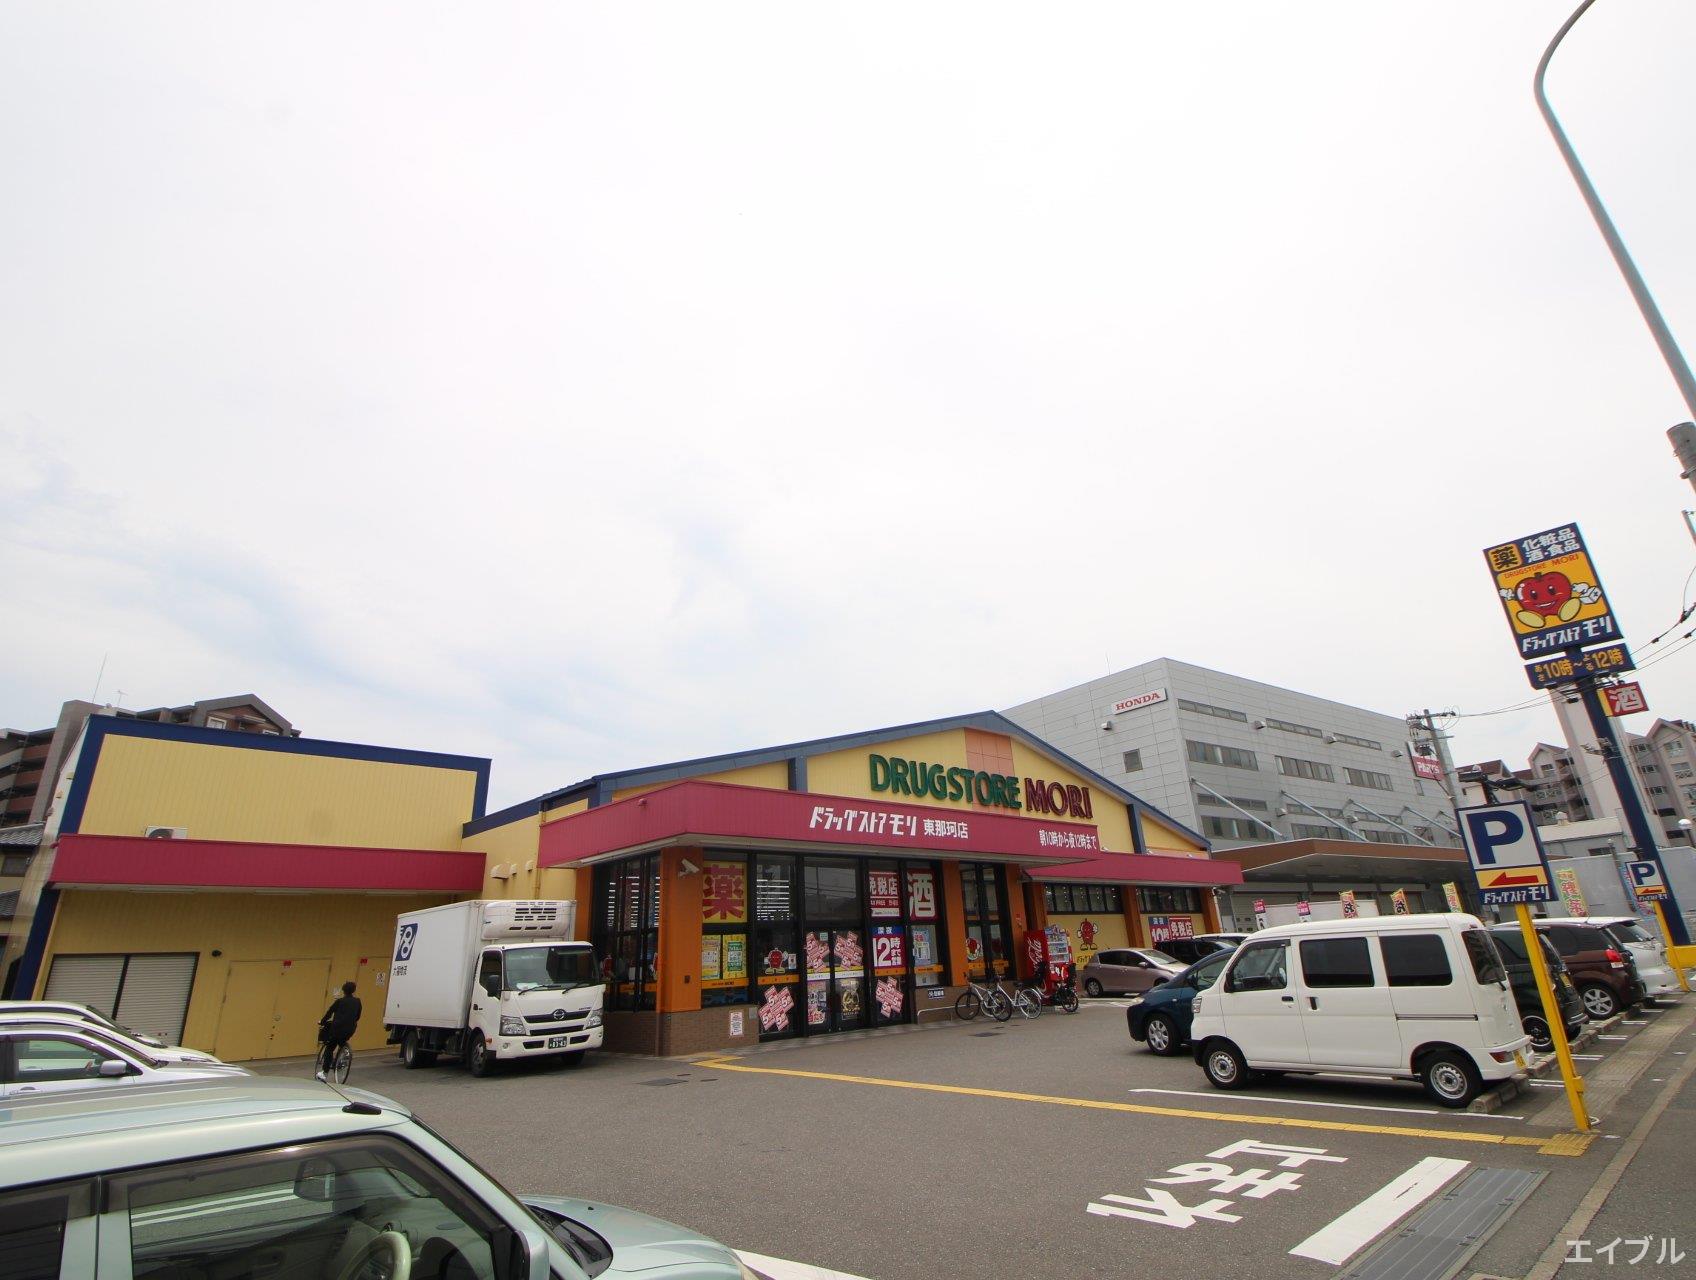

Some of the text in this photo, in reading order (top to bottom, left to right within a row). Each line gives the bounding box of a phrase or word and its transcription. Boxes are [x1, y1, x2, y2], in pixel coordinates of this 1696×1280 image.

[1522, 527, 1576, 552] 化粧品
[1491, 546, 1518, 568] 薬
[1504, 553, 1579, 579] DRUGSTORE MORI
[1116, 693, 1161, 710] HONDA
[1610, 687, 1642, 712] 酒
[869, 753, 1093, 820] DRUGSTORE MORI
[923, 818, 969, 839] 東那珂店
[1466, 810, 1523, 865] P
[869, 876, 898, 896] 免税店
[1630, 863, 1655, 885] P
[702, 863, 744, 920] 薬
[907, 872, 936, 917] 酒
[1171, 921, 1193, 937] 免税店
[1086, 1138, 1349, 1229] 止まれ
